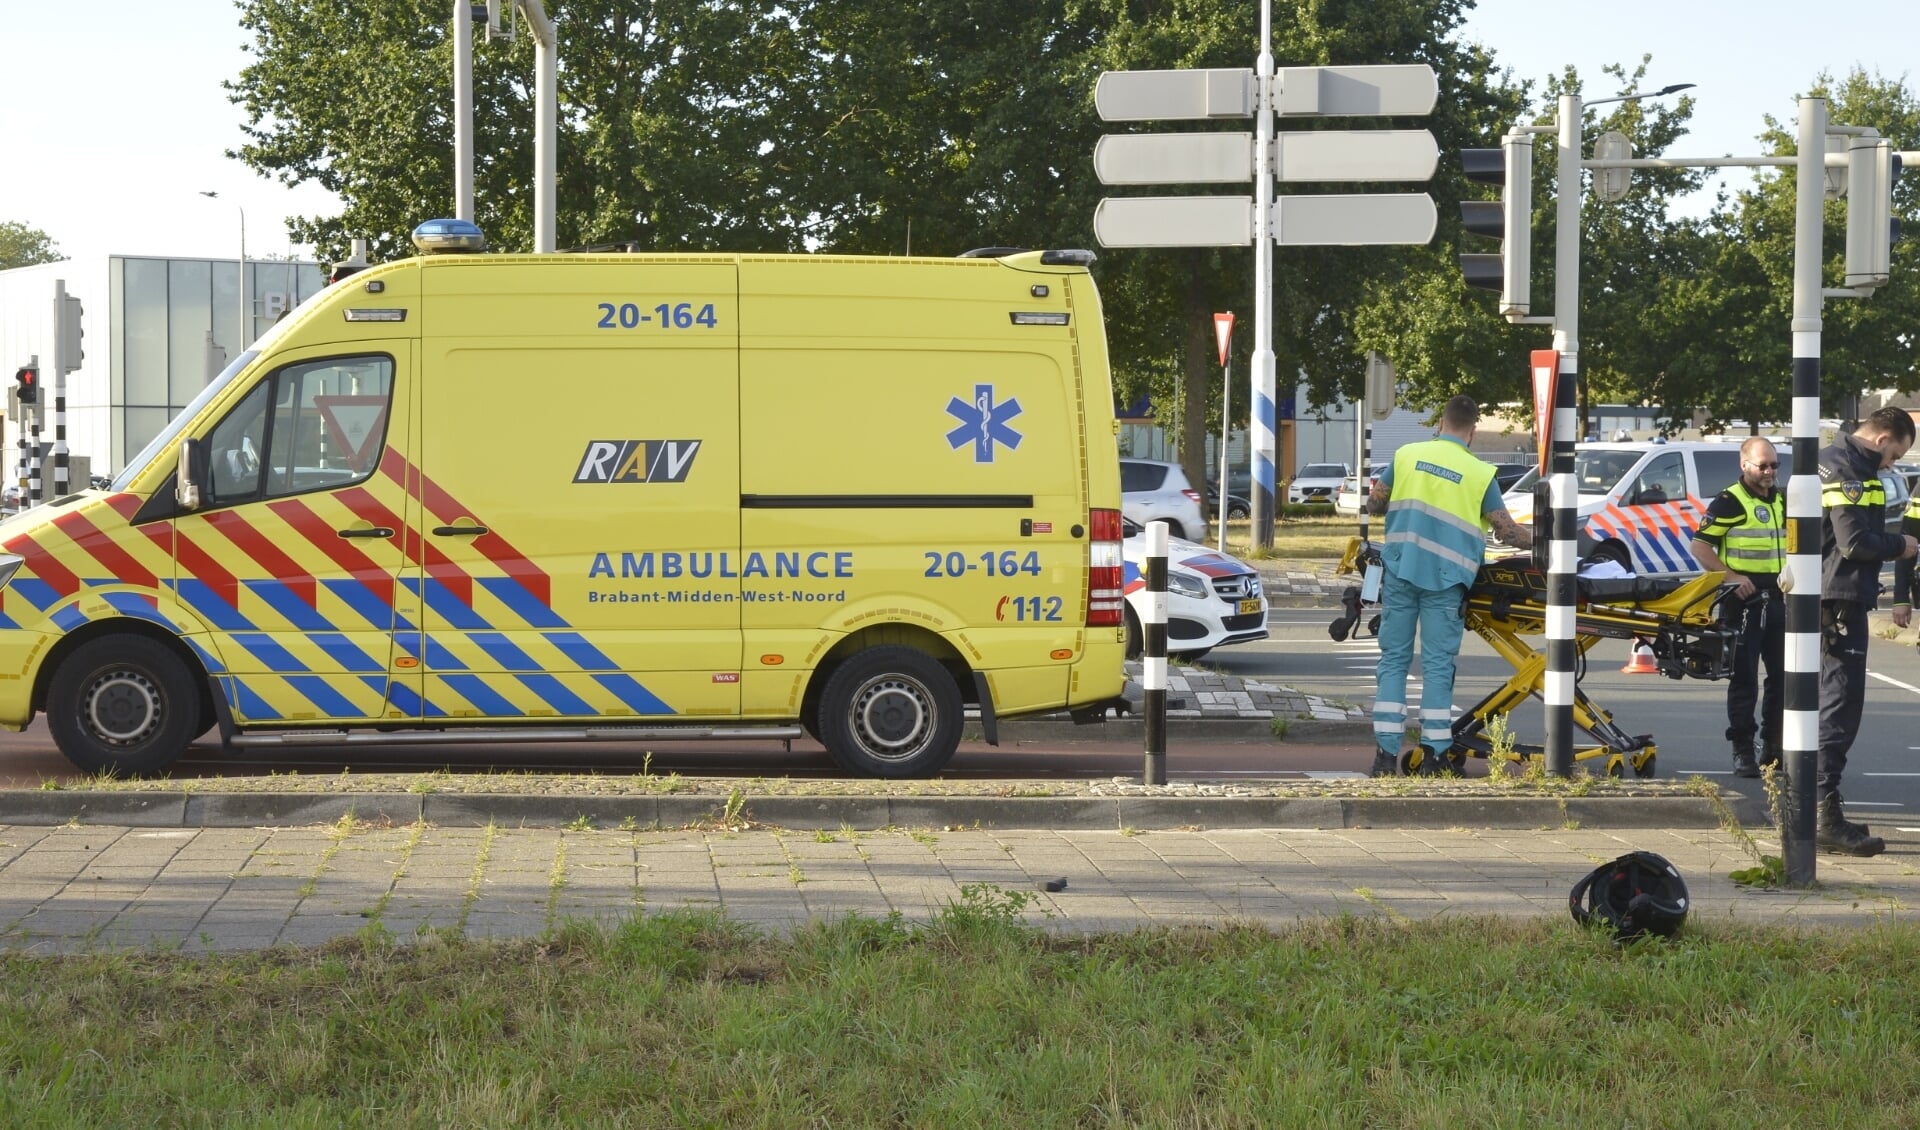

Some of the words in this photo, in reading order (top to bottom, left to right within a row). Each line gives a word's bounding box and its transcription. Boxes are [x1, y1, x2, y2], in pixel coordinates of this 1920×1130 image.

[597, 302, 718, 329] 20-164
[577, 442, 700, 480] RAV
[1416, 461, 1462, 483] AMBULANCE
[587, 551, 855, 579] AMBULANCE
[922, 550, 1043, 578] 20-164
[588, 590, 847, 603] Brabant-Midden-West-Noord
